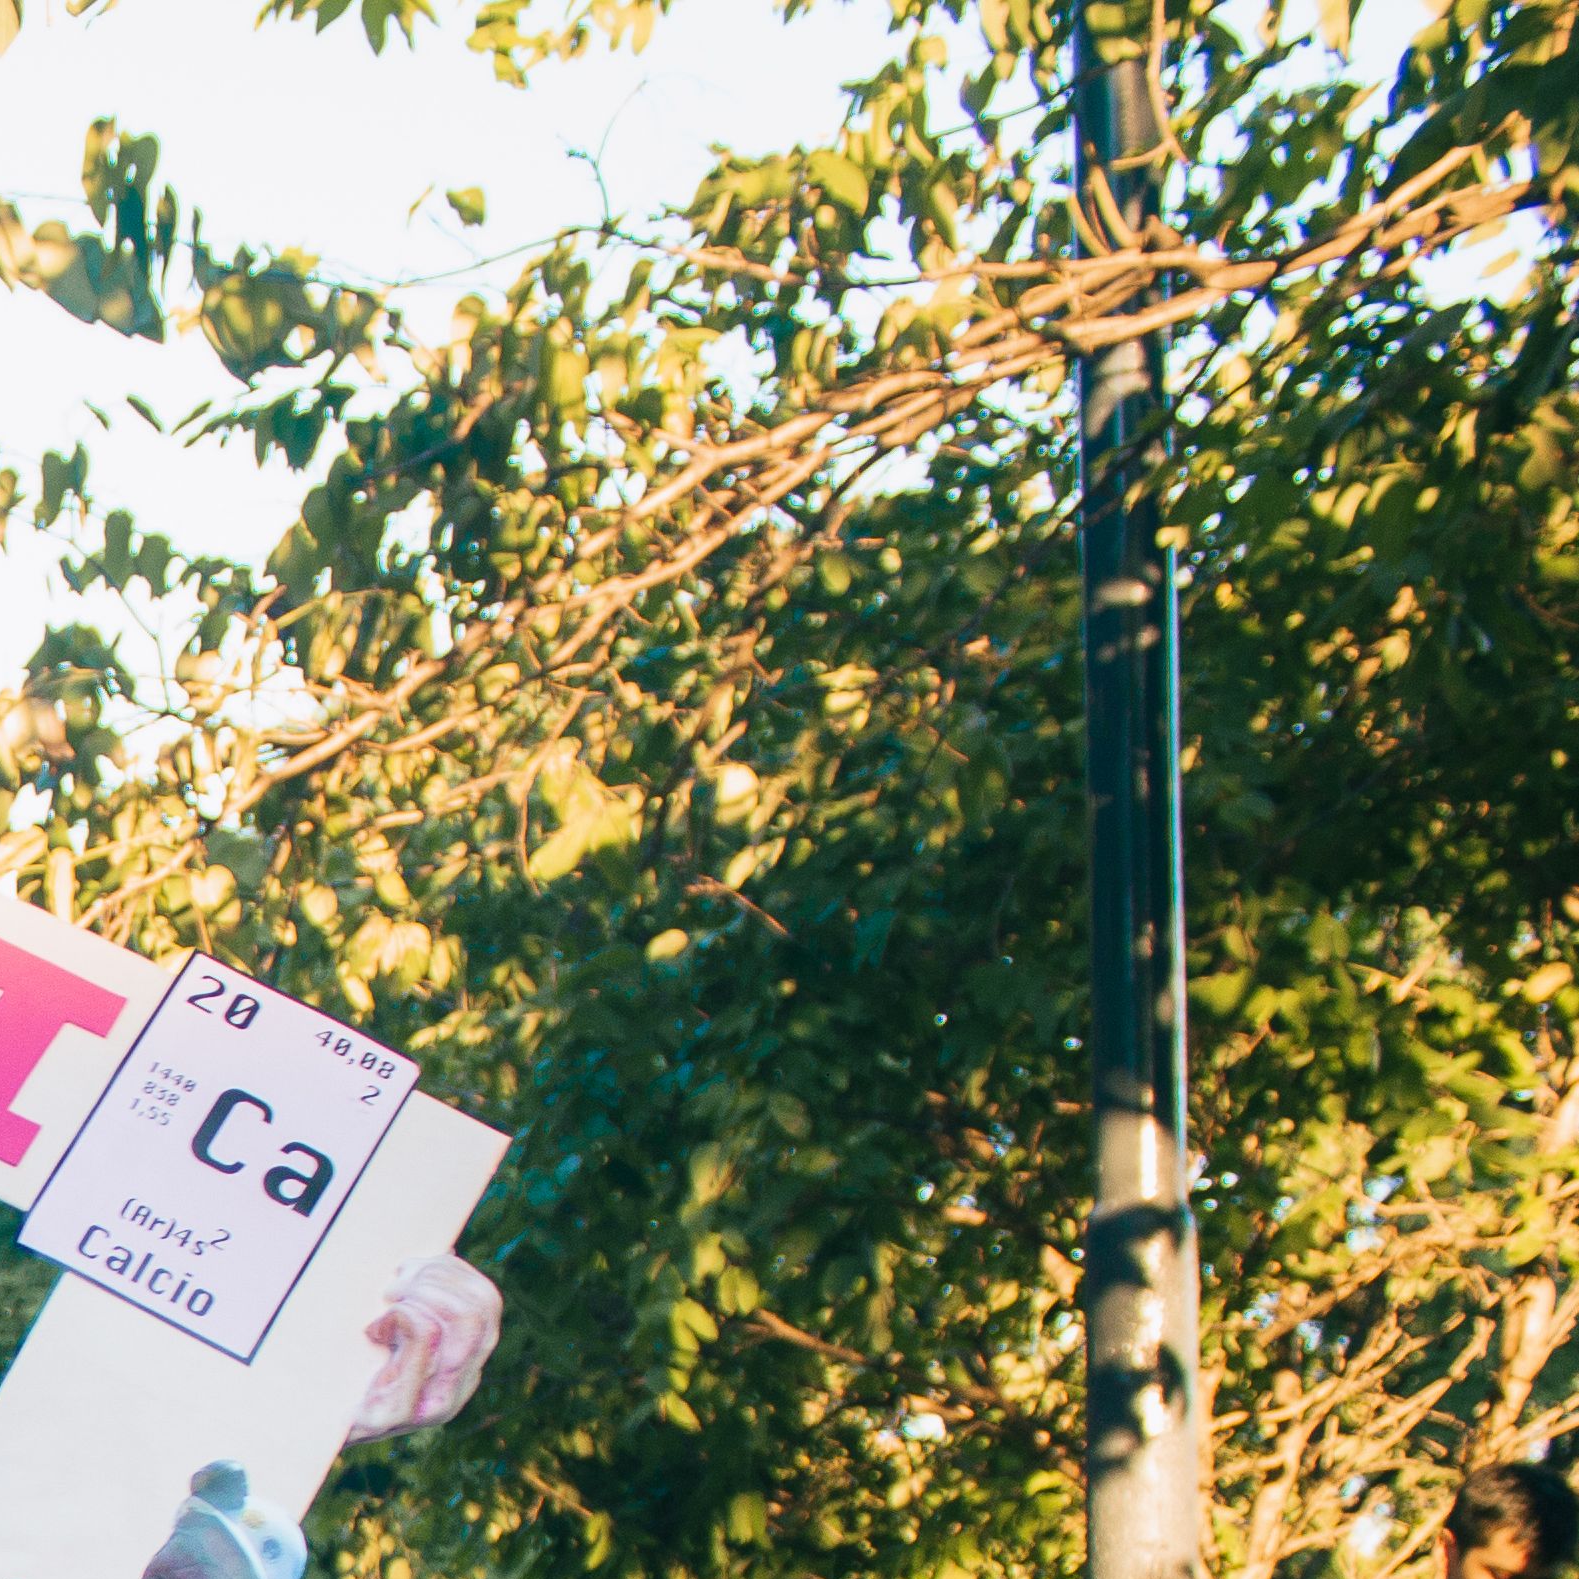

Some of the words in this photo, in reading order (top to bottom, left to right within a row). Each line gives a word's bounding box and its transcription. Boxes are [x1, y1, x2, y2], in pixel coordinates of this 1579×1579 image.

[186, 975, 261, 1030] 20
[315, 1030, 397, 1080] 40,08
[359, 1084, 382, 1107] 2
[190, 1087, 335, 1218] Ca
[77, 1224, 216, 1317] Calcio
